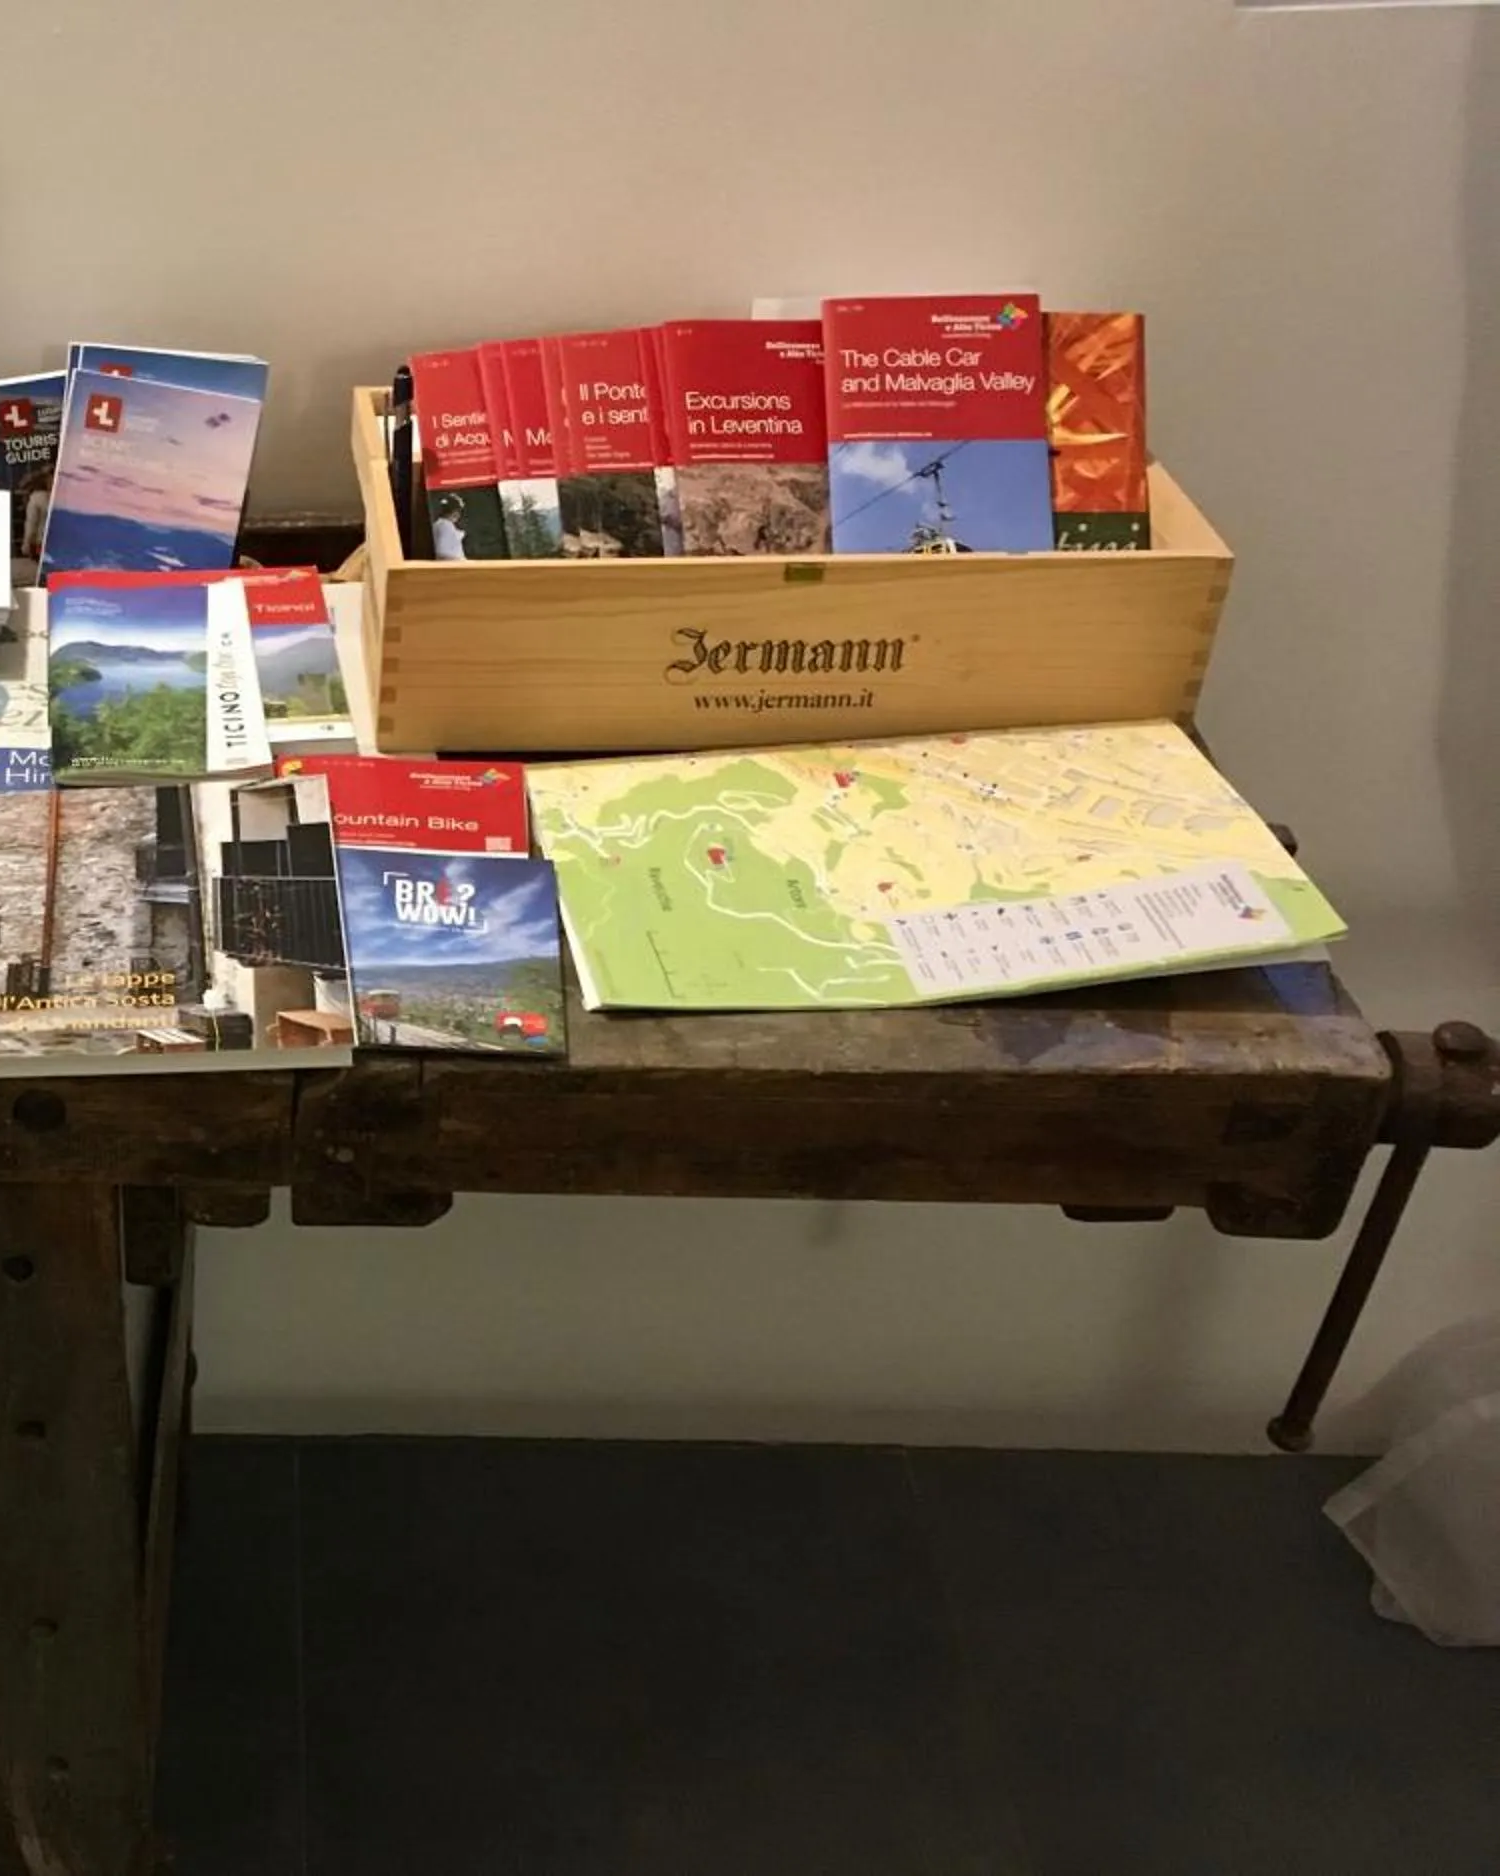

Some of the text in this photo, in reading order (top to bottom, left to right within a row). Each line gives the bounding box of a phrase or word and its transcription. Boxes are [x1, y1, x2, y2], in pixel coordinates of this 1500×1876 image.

[840, 347, 982, 368] The Cable Car
[841, 371, 1036, 395] and Malvaglia Valley
[685, 391, 792, 411] Excursions
[582, 411, 596, 425] e
[688, 415, 803, 435] in Leventina
[4, 434, 59, 451] TOURIS
[5, 449, 51, 464] GUIDE
[663, 627, 905, 686] Jermann
[694, 688, 874, 713] www.jermann.it
[334, 813, 480, 832] ountain Bike
[396, 902, 476, 927] WOW!
